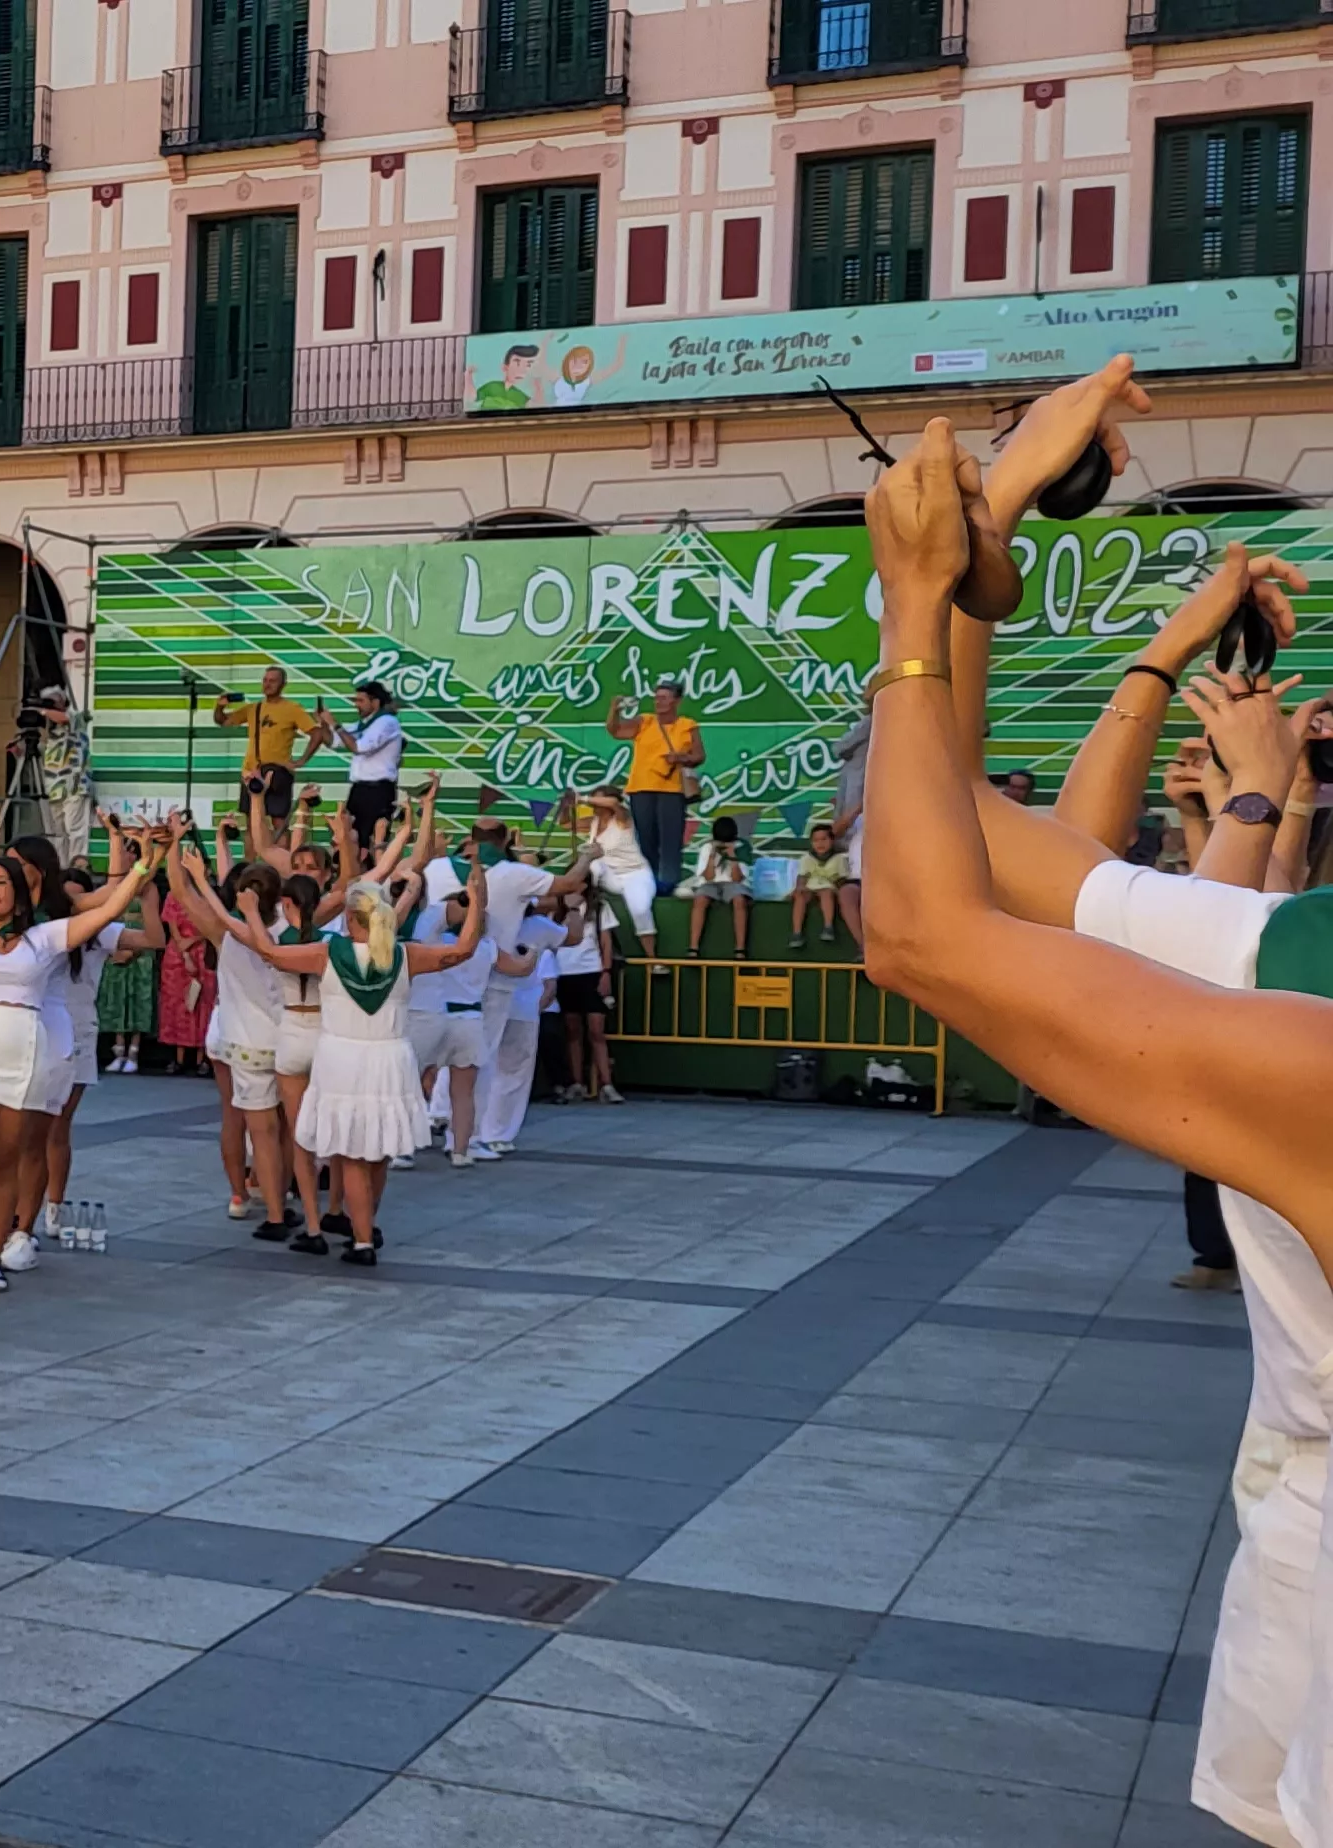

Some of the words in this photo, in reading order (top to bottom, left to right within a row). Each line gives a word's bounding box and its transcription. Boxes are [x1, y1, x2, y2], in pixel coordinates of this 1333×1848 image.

[669, 335, 721, 358] Baila
[727, 338, 755, 353] con
[761, 331, 833, 350] nosotros
[642, 361, 660, 381] la
[658, 360, 697, 384] jota
[704, 356, 726, 376] de
[731, 352, 765, 375] San
[771, 350, 851, 375] Lorenzo
[302, 560, 425, 630] SAN
[491, 661, 601, 708] unas
